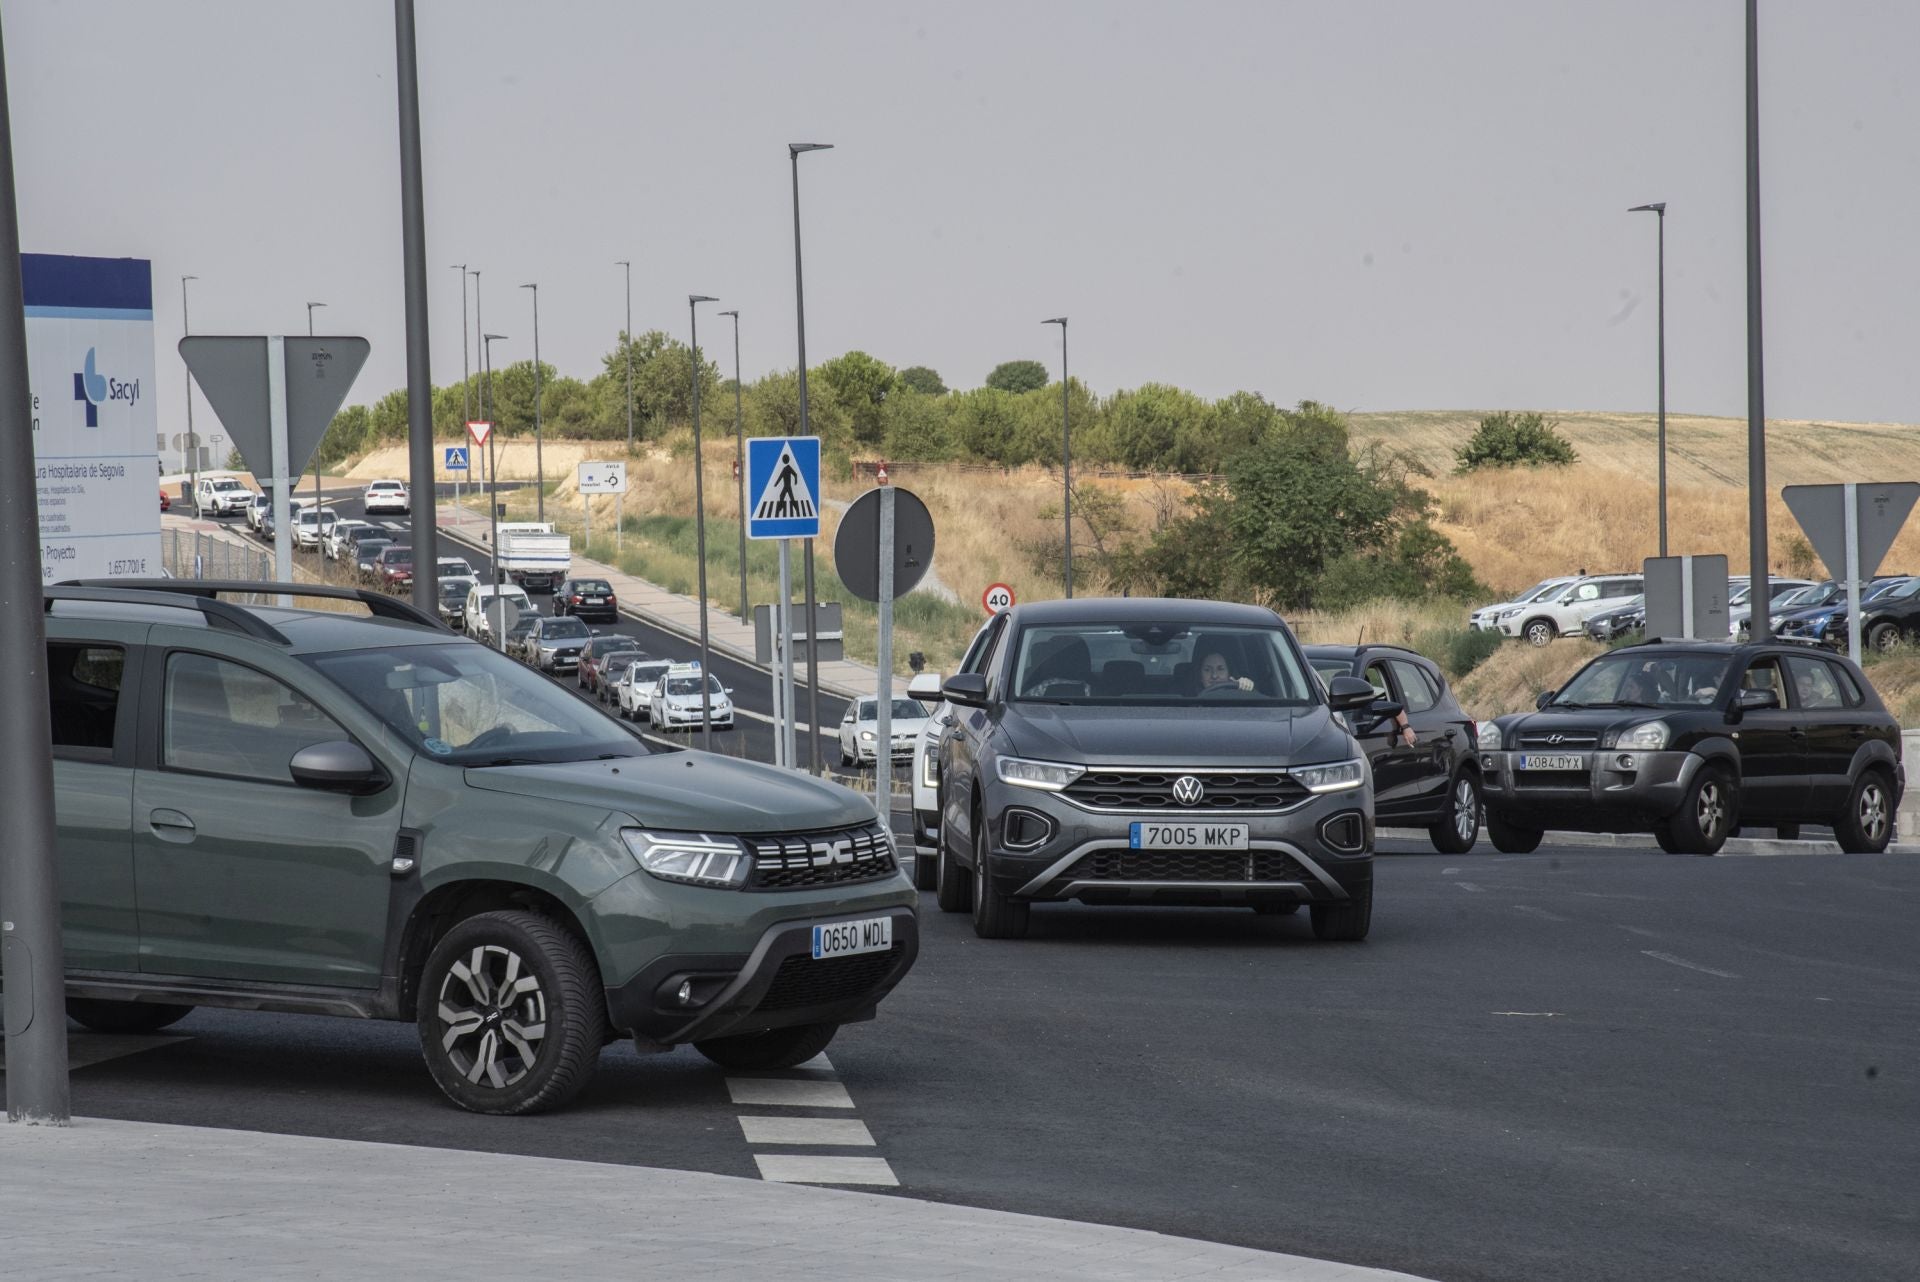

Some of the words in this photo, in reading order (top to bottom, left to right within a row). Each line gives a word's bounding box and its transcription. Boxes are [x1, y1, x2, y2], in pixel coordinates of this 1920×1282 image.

[110, 377, 140, 407] Sacyl
[48, 464, 88, 480] Hospitalaria
[89, 464, 98, 478] de
[99, 463, 125, 481] Segovia
[46, 545, 76, 562] Proyecto
[108, 559, 140, 575] 1.657.700
[140, 558, 146, 573] €
[989, 594, 1009, 606] 40
[1527, 756, 1554, 768] 4084
[1558, 757, 1580, 769] DYX
[1148, 827, 1197, 845] 7005
[1204, 828, 1241, 846] MKP
[823, 926, 858, 953] 0650
[863, 921, 889, 948] MDL
